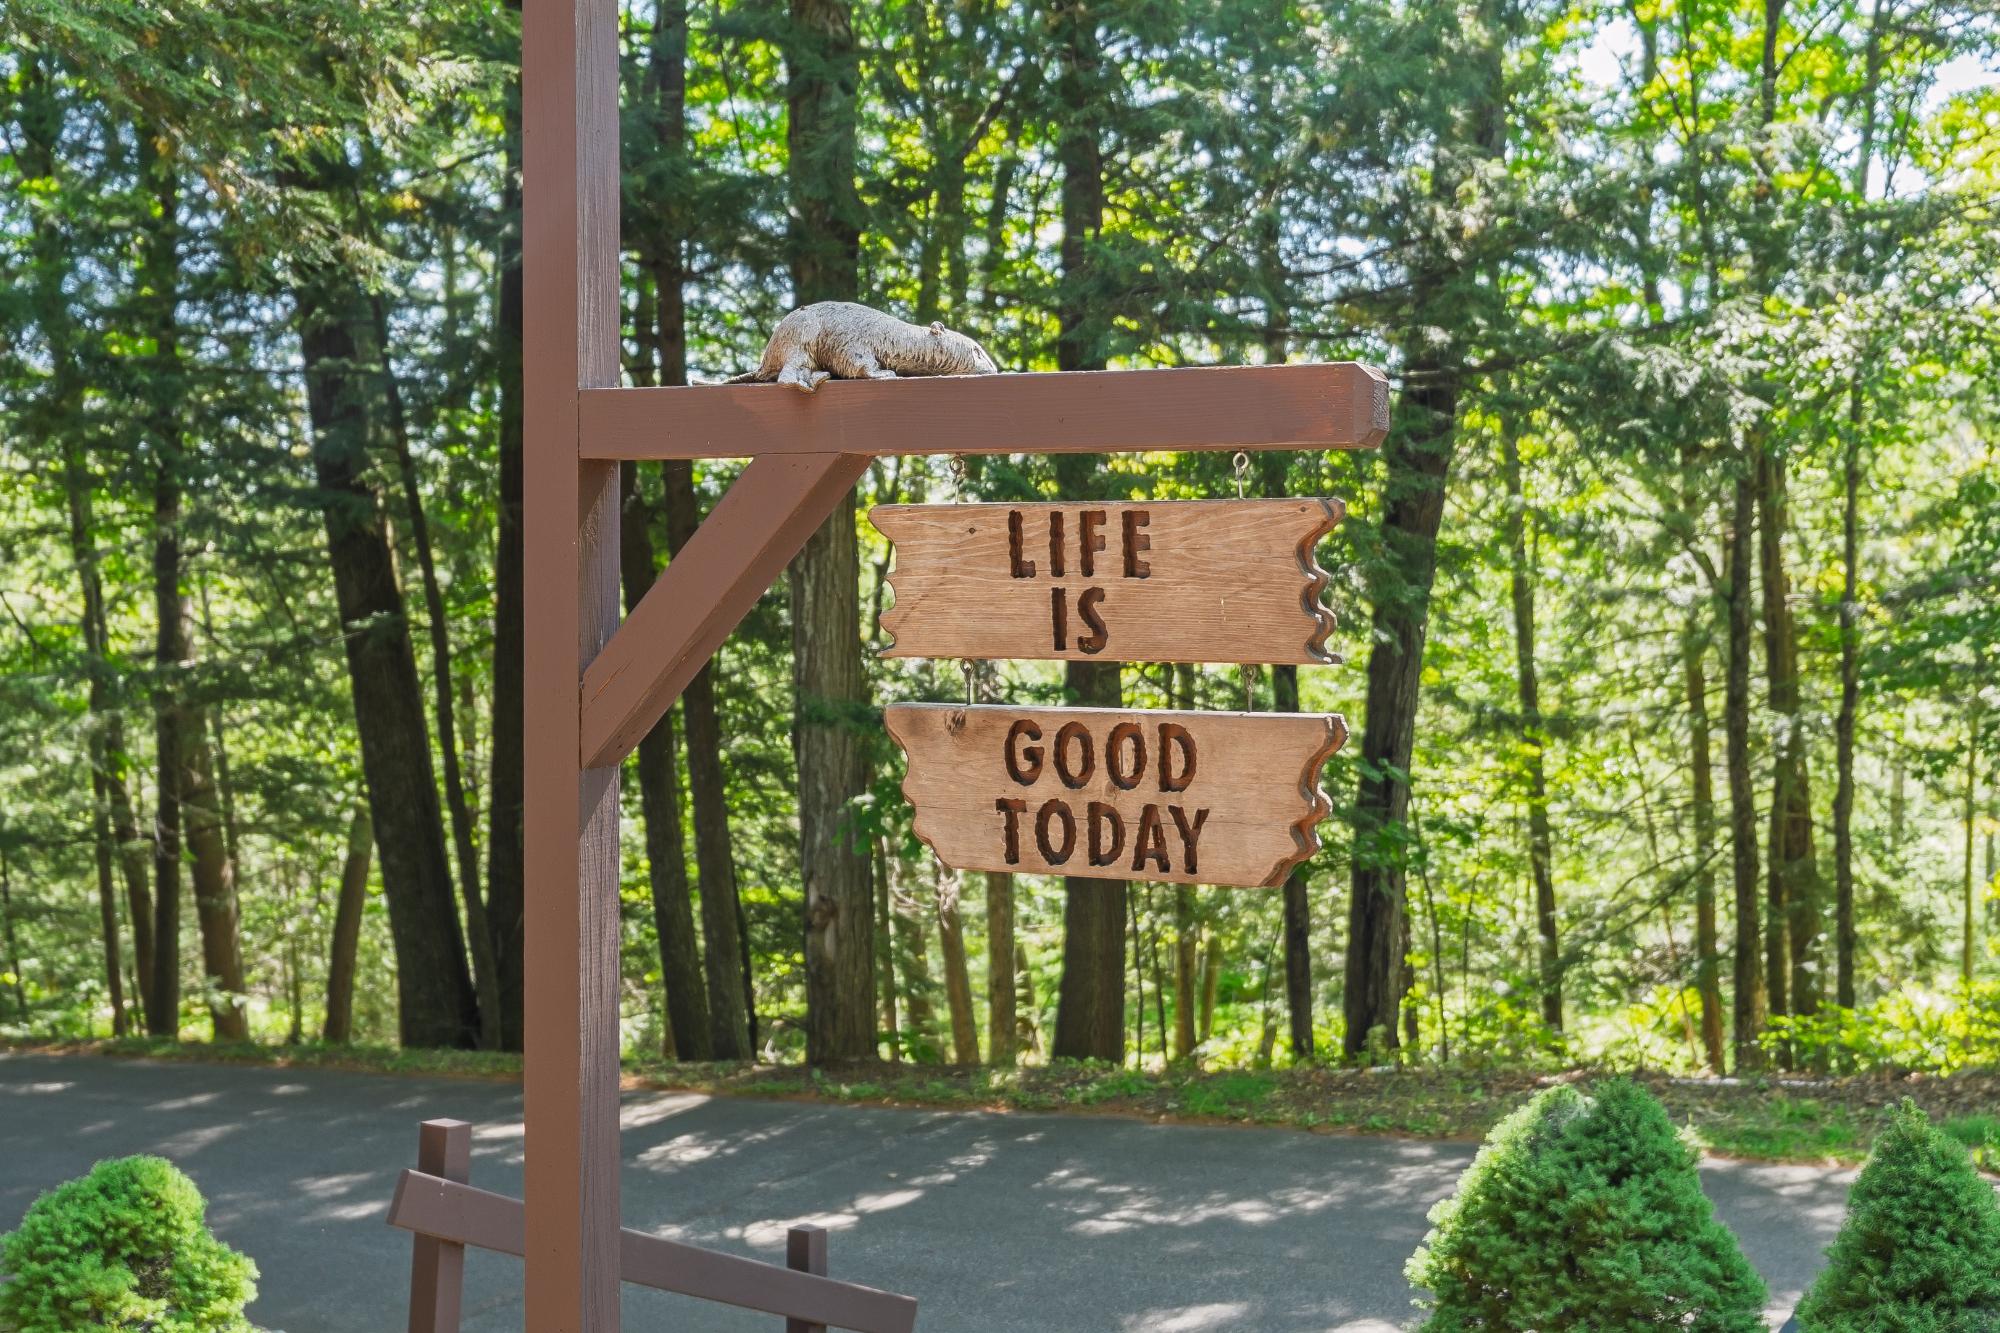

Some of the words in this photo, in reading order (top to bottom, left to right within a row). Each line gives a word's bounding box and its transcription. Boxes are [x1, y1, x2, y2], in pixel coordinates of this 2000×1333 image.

[1008, 509, 1151, 579] LIFE
[1051, 586, 1109, 655] IS
[1004, 719, 1197, 793] GOOD
[995, 797, 1210, 875] TODAY
